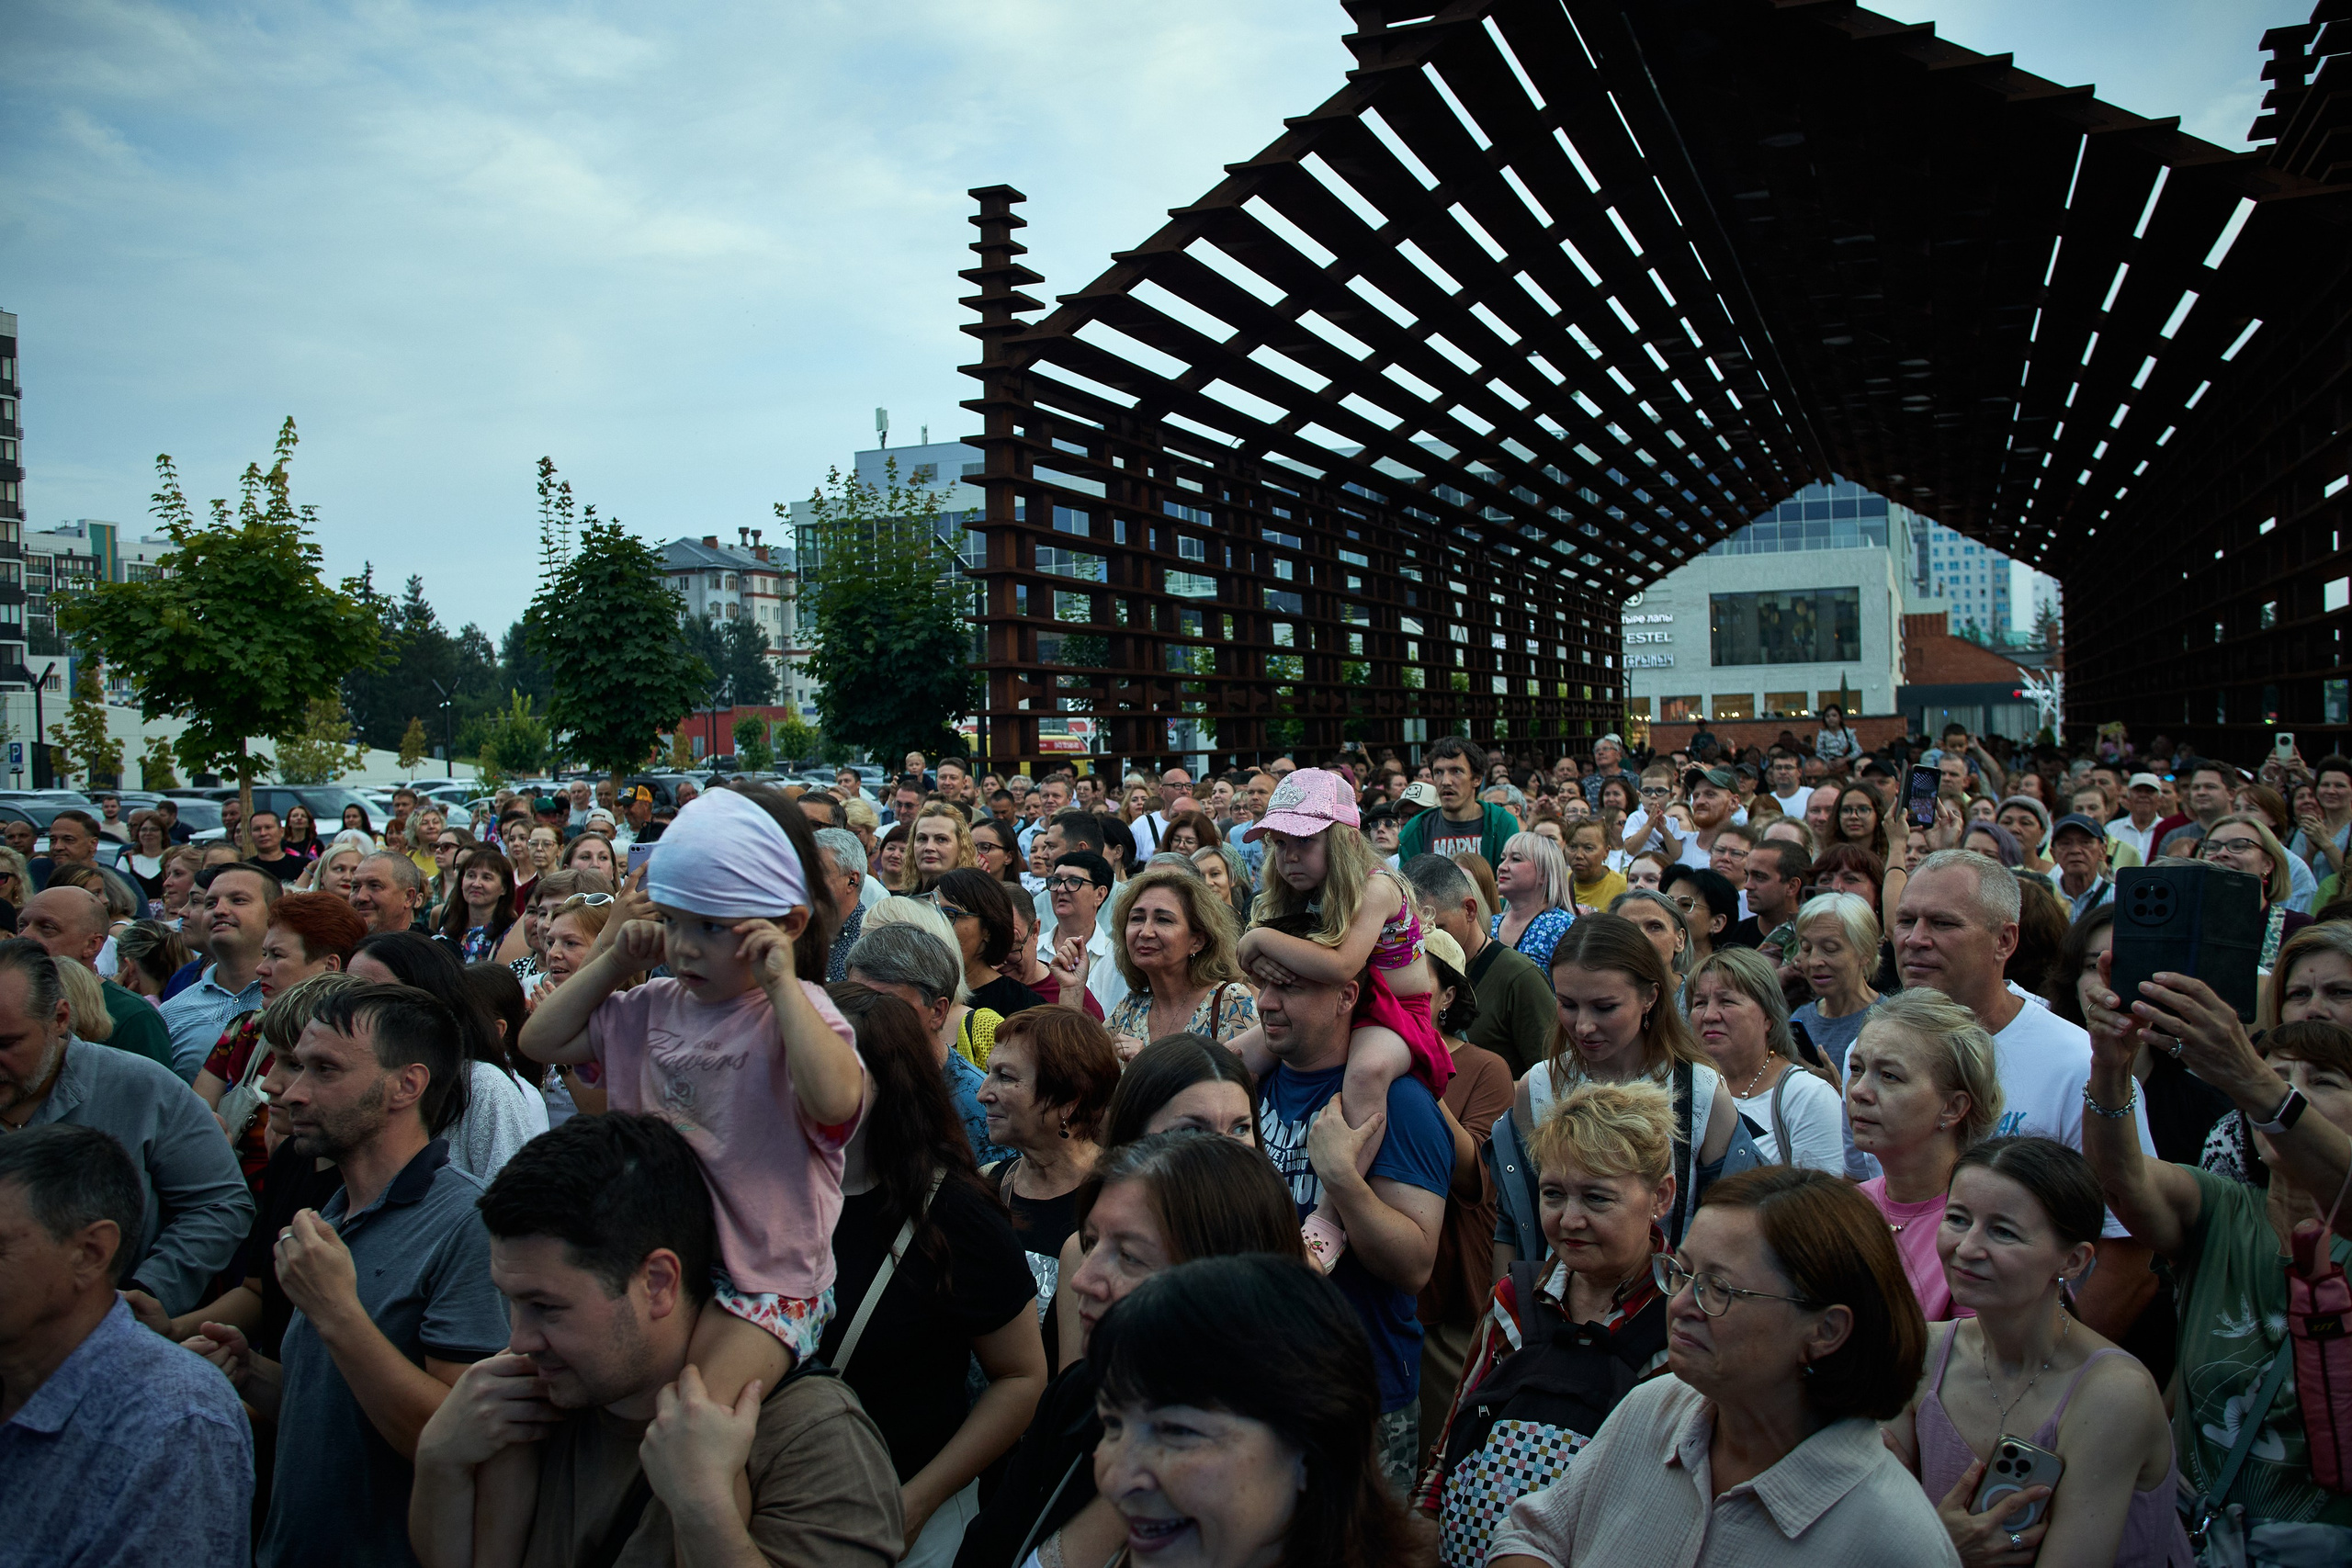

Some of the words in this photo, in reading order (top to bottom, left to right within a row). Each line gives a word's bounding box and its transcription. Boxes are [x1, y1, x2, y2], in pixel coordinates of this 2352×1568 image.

[1621, 615, 1646, 625] тыре
[1646, 614, 1673, 624] лапы
[1626, 631, 1673, 644] ESTEL
[647, 1027, 750, 1072] Flowers
